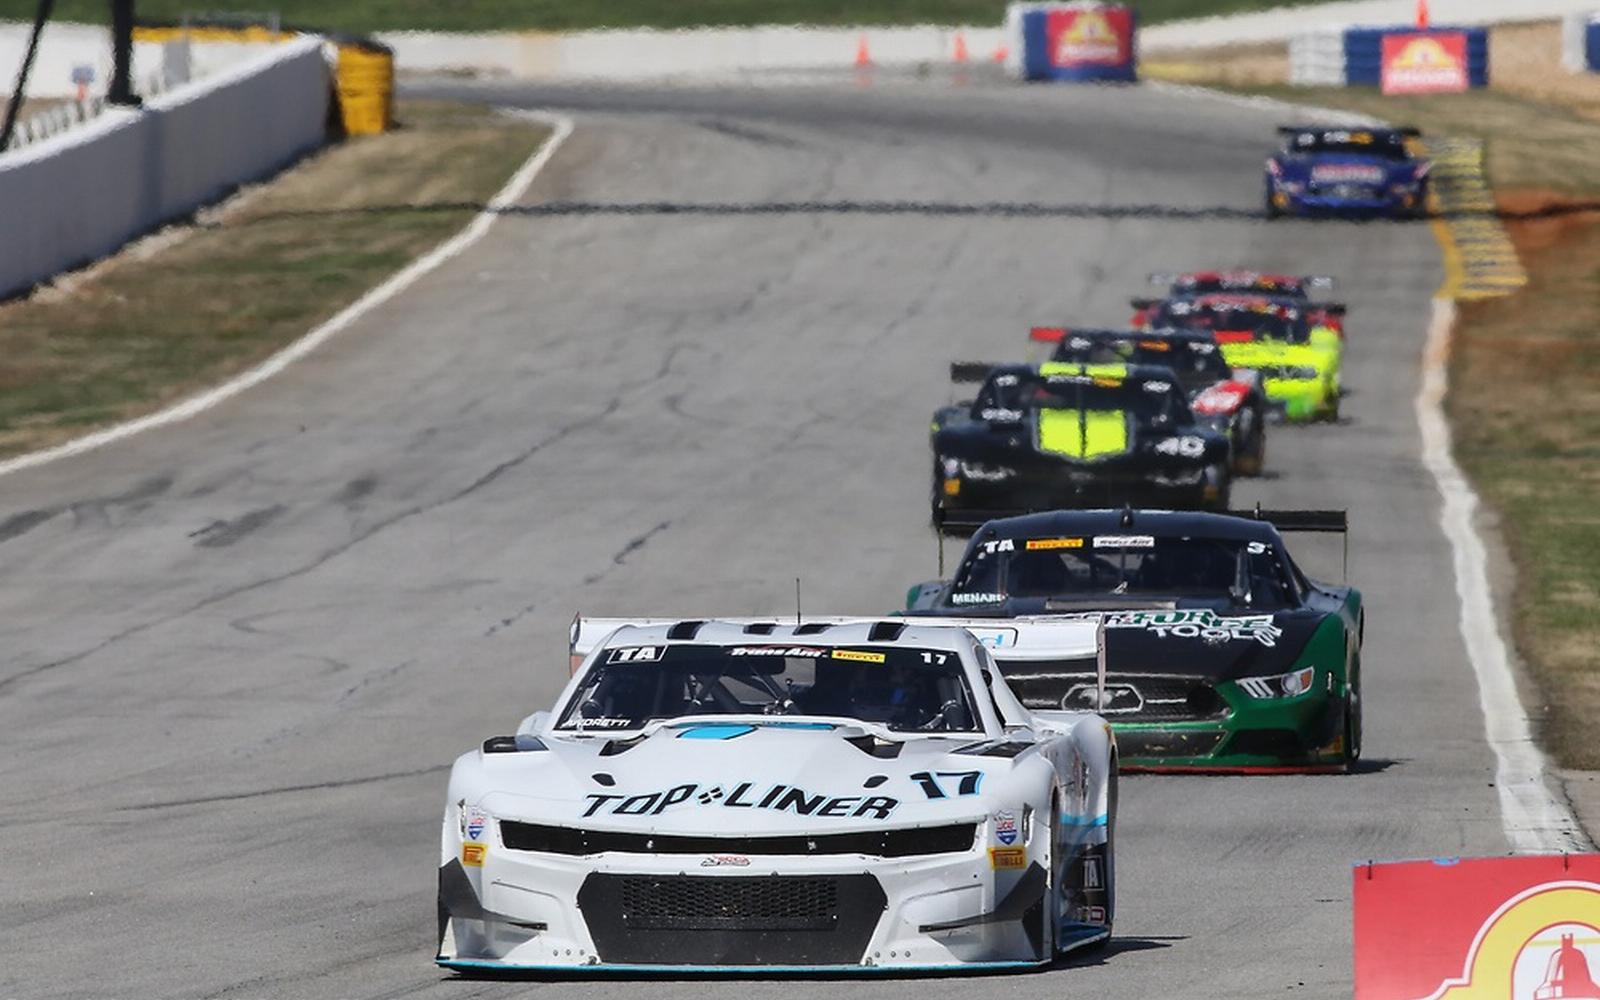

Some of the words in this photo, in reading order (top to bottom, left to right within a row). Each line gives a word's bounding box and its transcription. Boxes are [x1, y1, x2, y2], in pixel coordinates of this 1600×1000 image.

[984, 539, 1015, 553] TA
[619, 647, 656, 661] TA
[920, 652, 947, 665] 17
[908, 770, 985, 799] 17
[582, 783, 700, 818] TOP
[722, 782, 901, 820] LINER
